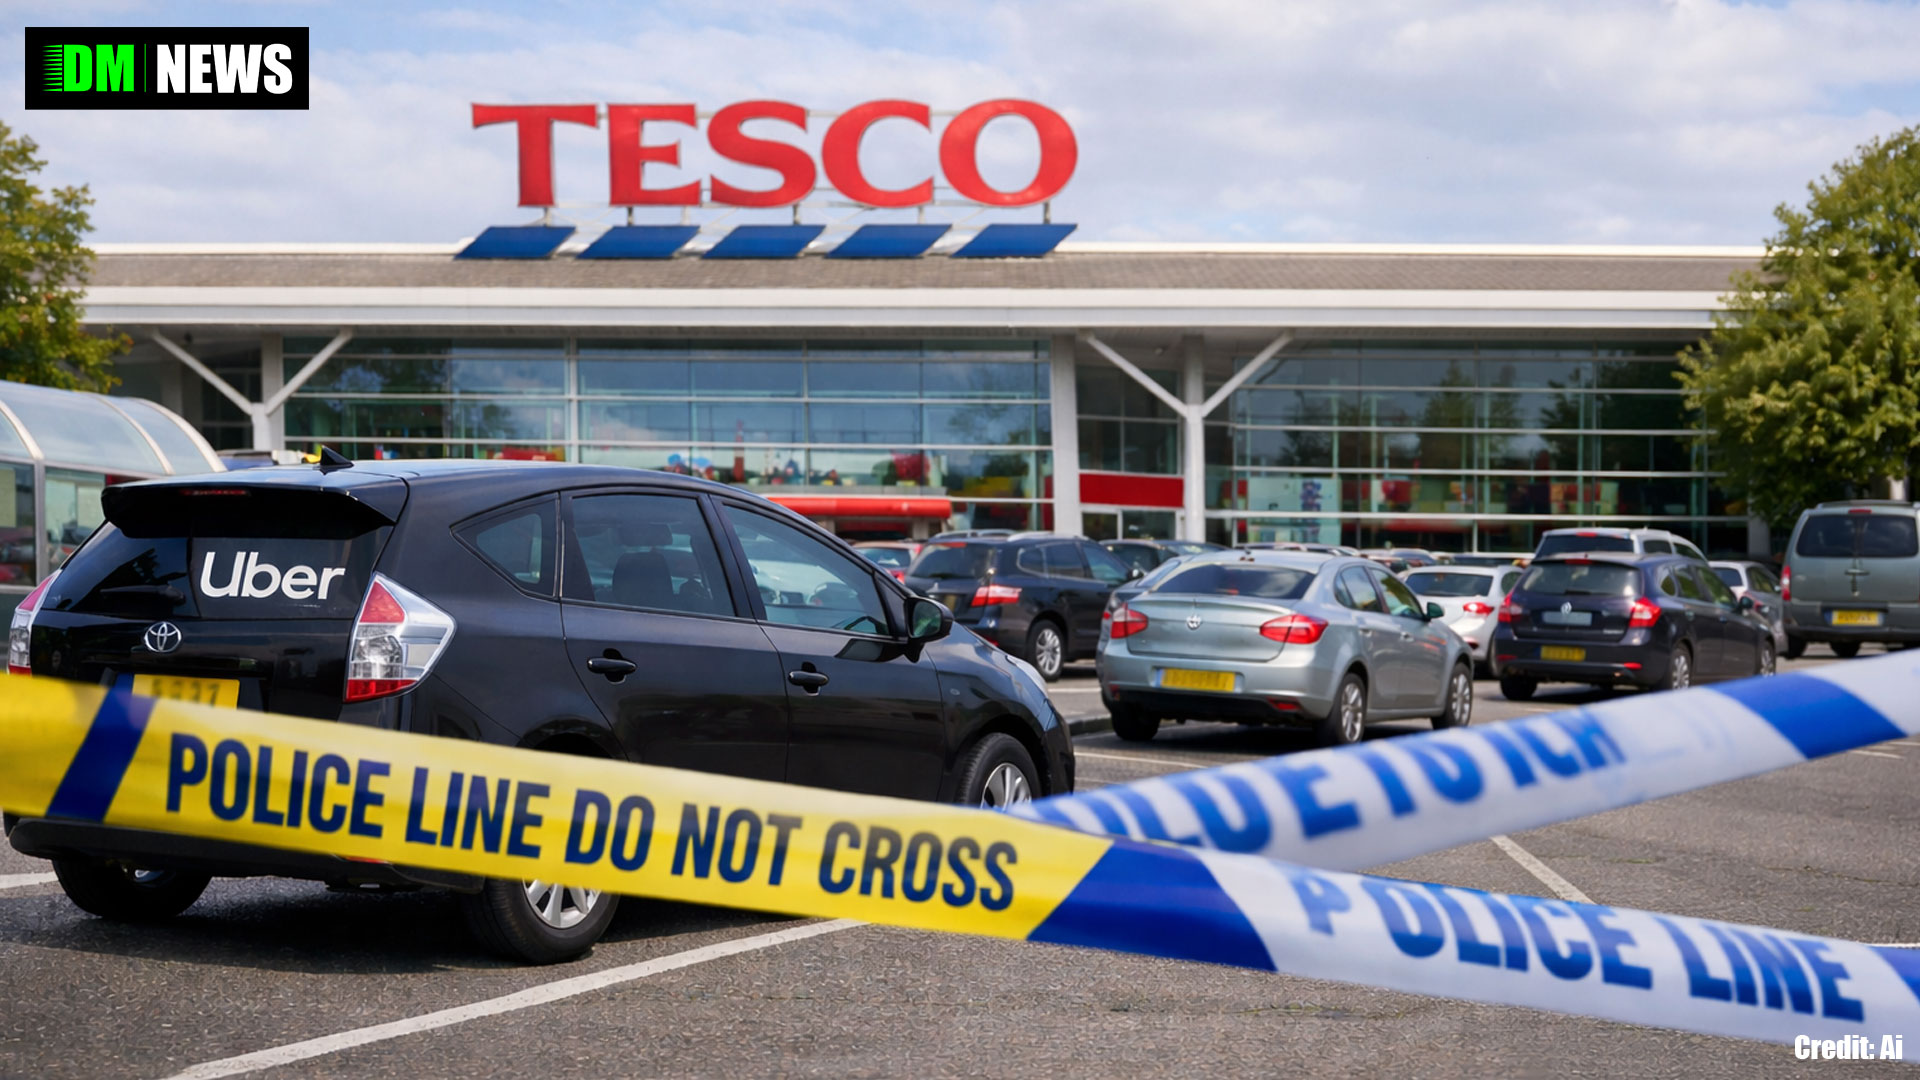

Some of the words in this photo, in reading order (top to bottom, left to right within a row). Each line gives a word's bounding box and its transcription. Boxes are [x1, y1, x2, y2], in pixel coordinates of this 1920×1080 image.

[471, 98, 1079, 208] TESCO
[200, 551, 347, 600] Uber
[166, 731, 392, 839] POLICE
[404, 765, 551, 859] LINE
[564, 788, 656, 872] DO
[670, 801, 803, 887] NOT
[817, 820, 1018, 912] CROSS
[1652, 915, 1866, 1024] LINE
